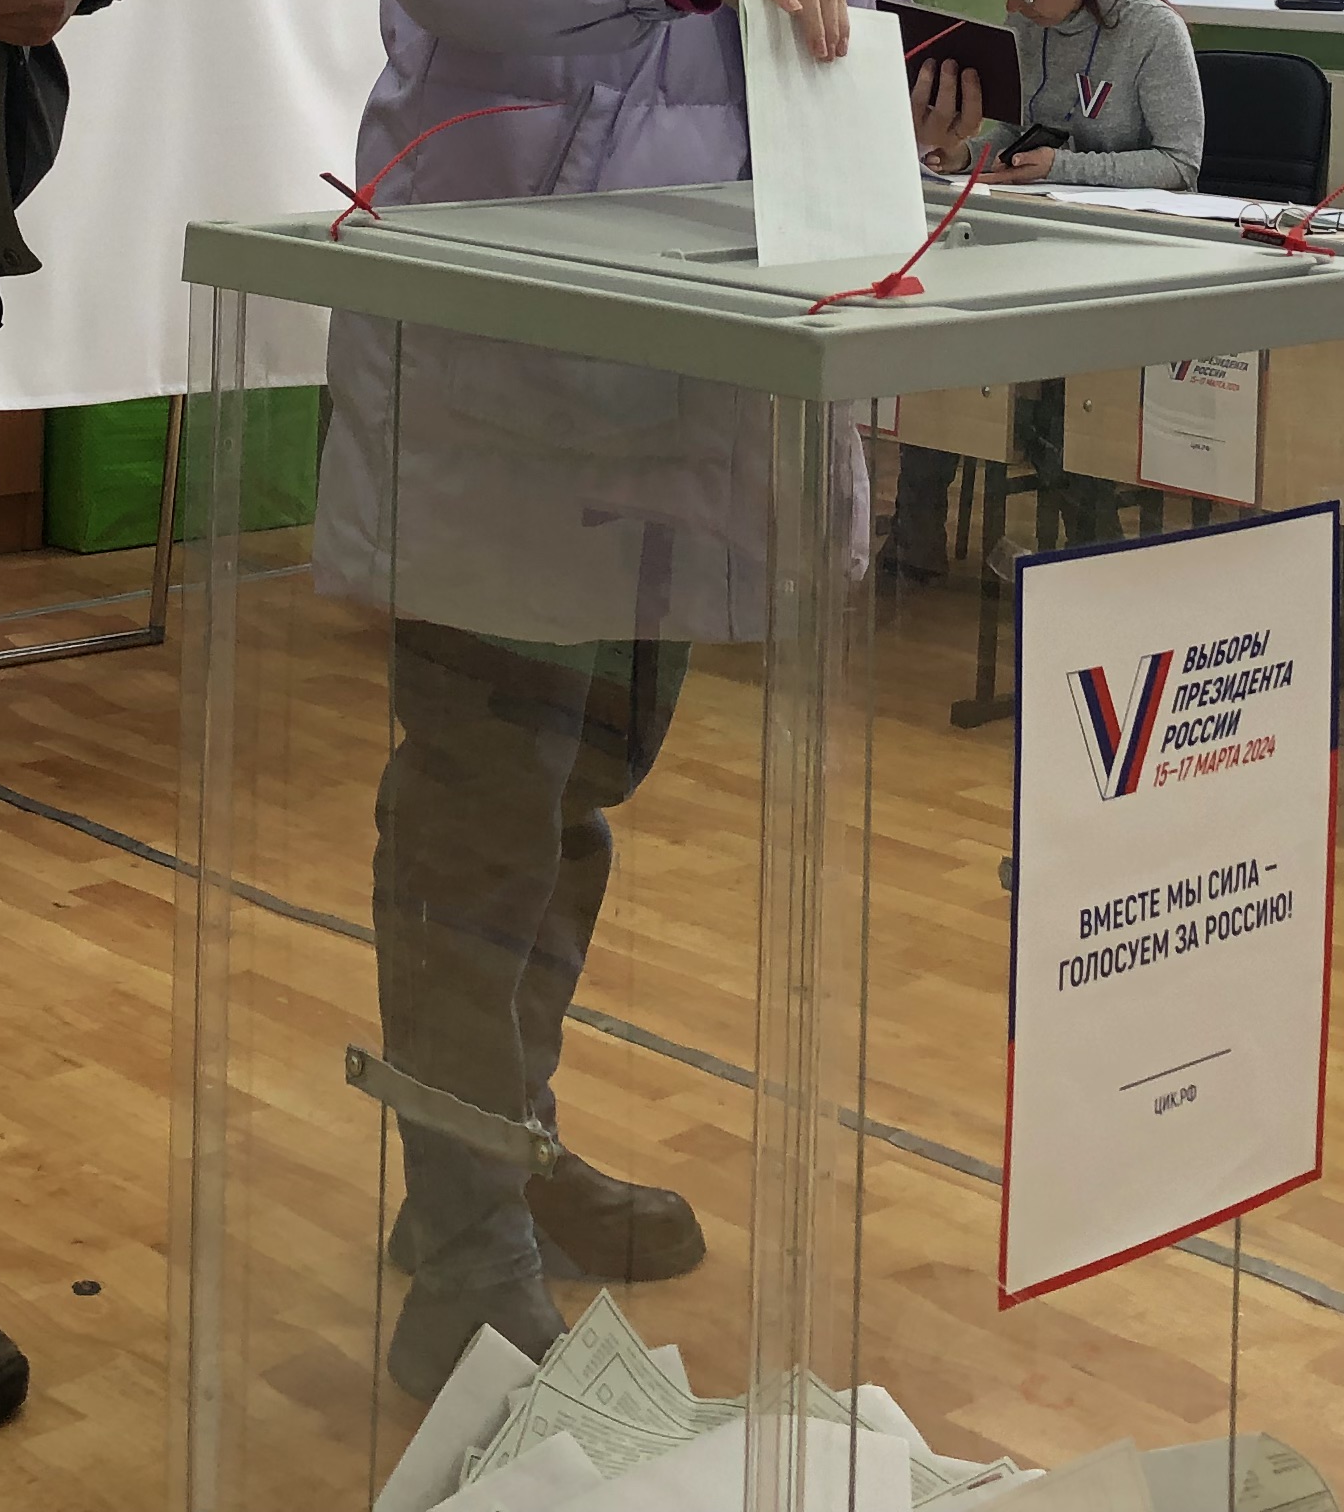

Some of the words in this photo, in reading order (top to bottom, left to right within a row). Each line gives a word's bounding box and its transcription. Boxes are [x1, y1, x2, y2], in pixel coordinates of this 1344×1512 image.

[1181, 628, 1271, 675] ВЫБОРЫ
[1170, 659, 1295, 715] ПРЕЗИДЕНТА
[1159, 707, 1243, 754] РОССИИ
[1192, 743, 1242, 778] МАРТА
[1242, 734, 1277, 766] 2024
[1079, 887, 1161, 940] ВМЕСТЕ
[1166, 874, 1203, 913] МЫ
[1208, 858, 1261, 901] СИЛА
[1058, 928, 1170, 992] ГОЛОСУЕМ
[1174, 920, 1200, 955] ЗА
[1204, 890, 1294, 945] РОССИЮ!
[1153, 1083, 1198, 1115] ЦИК.РФ
